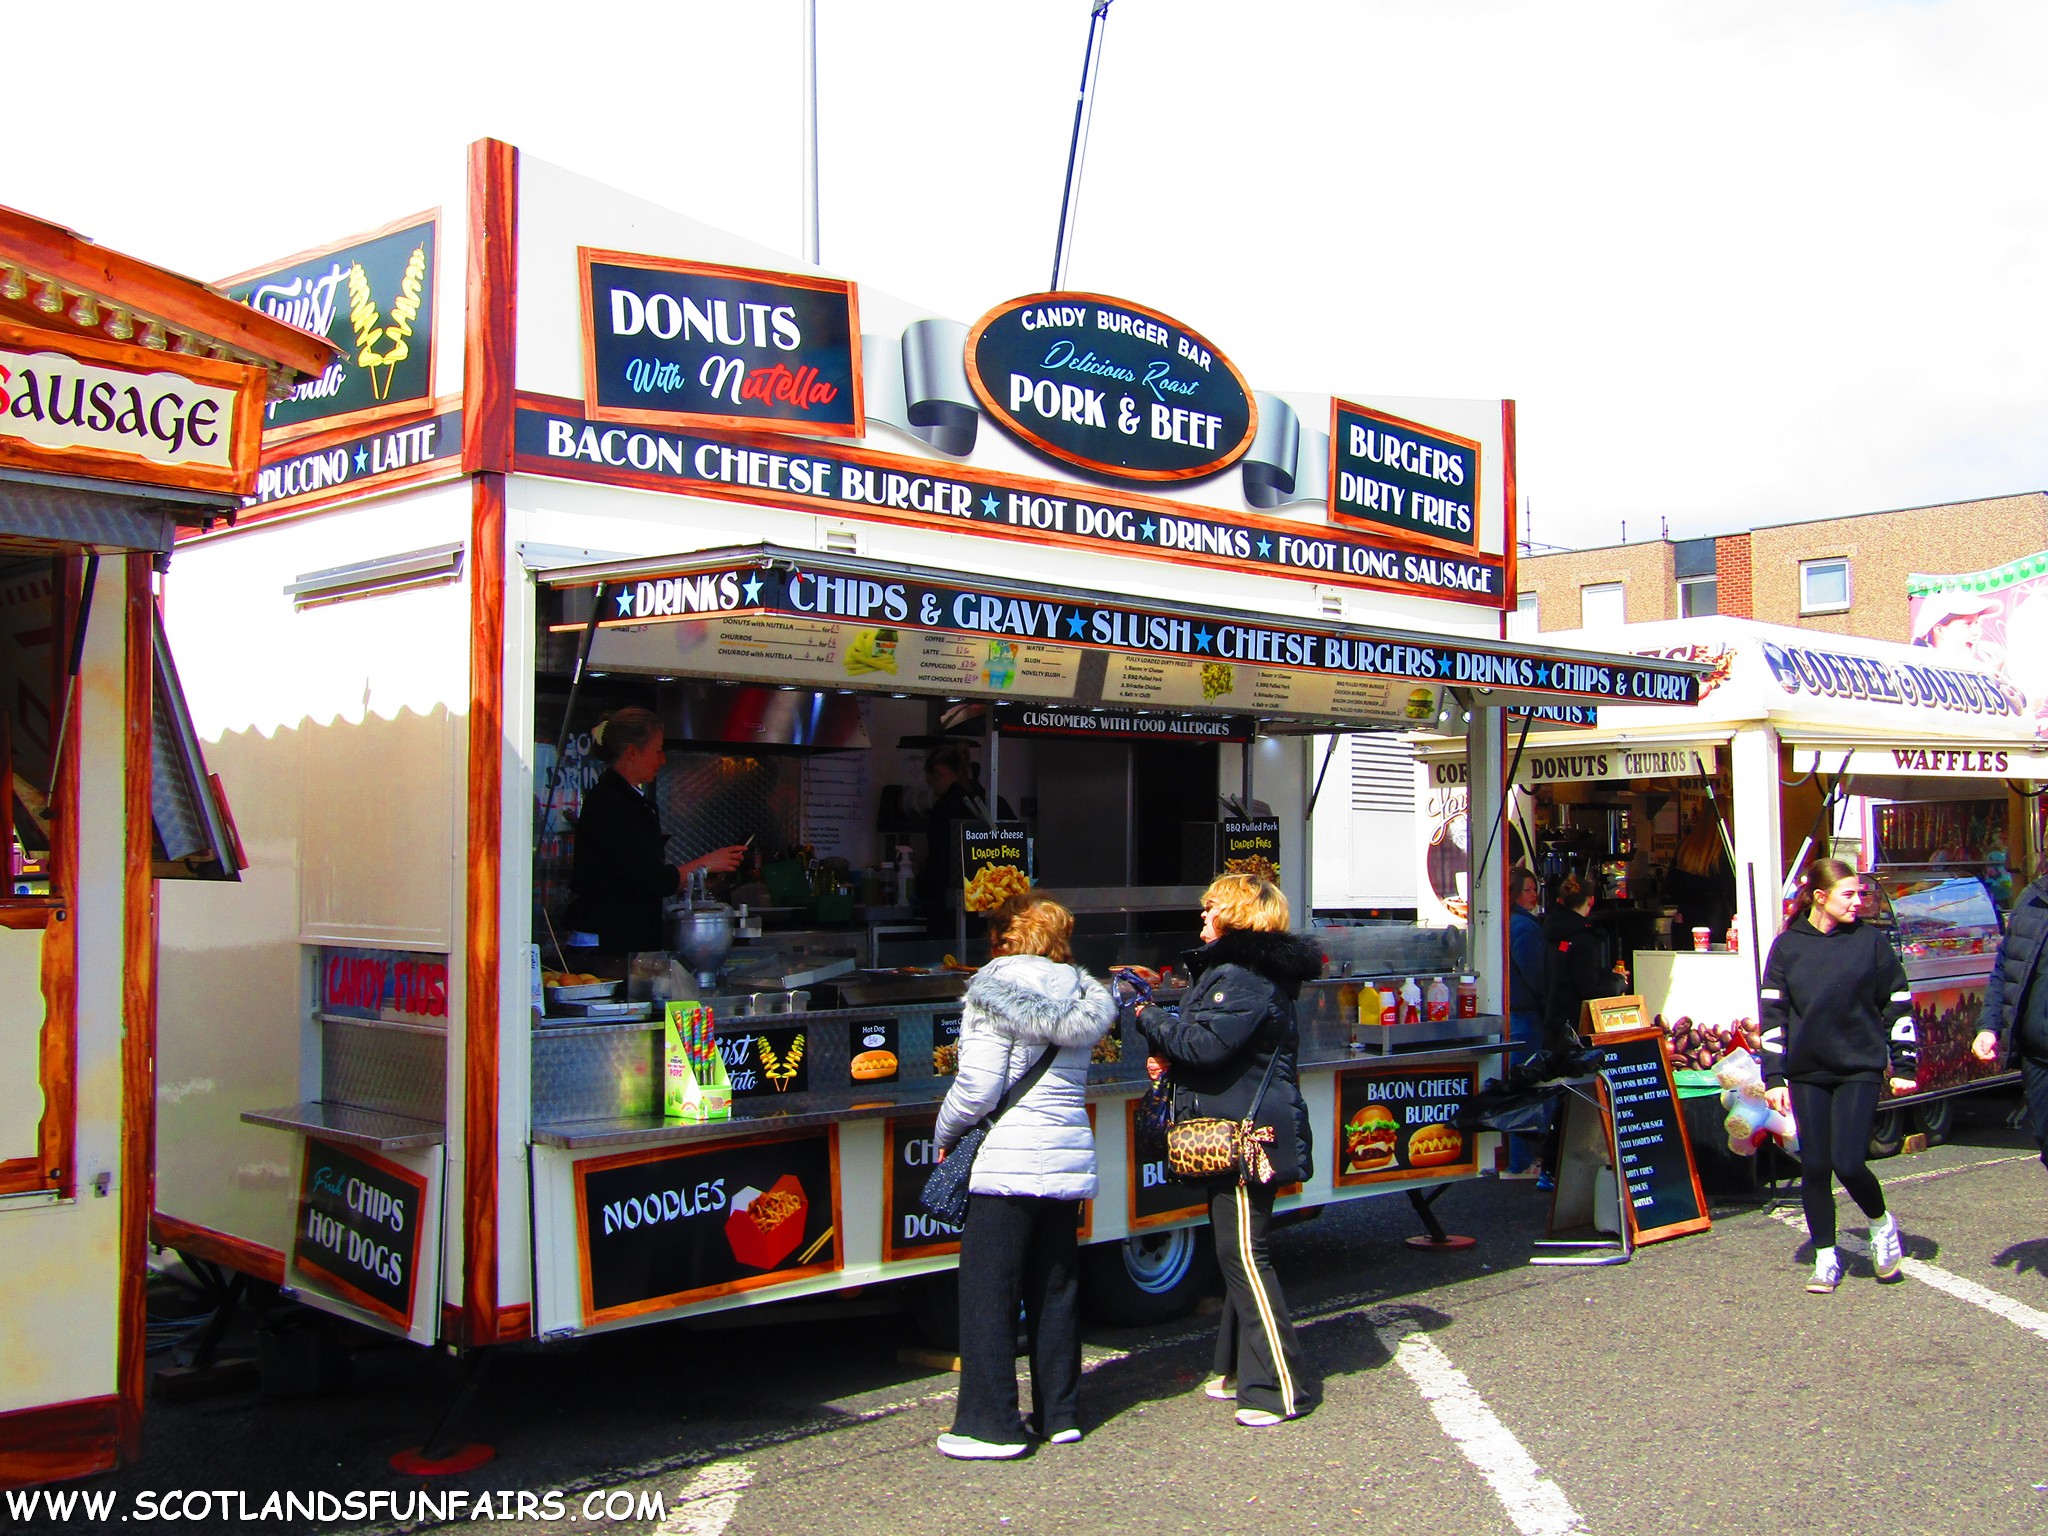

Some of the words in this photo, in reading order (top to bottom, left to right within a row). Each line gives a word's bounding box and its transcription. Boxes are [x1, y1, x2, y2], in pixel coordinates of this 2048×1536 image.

[611, 289, 801, 351] DONUTS
[1021, 308, 1087, 331] CANDY
[1097, 310, 1169, 348] BURGER
[1177, 336, 1212, 373] BAR
[625, 357, 685, 394] With
[699, 355, 838, 410] Nutella
[1040, 340, 1136, 383] Delicious
[1141, 361, 1200, 401] Roast
[1010, 373, 1107, 428] PORK
[1118, 397, 1141, 435] &
[1151, 403, 1222, 450] BEEF
[373, 423, 436, 474] LATTE
[1350, 423, 1464, 487] BURGERS
[547, 420, 682, 474] BACON
[694, 444, 831, 497] CHEESE
[841, 466, 972, 519] BURGER
[1008, 493, 1068, 531] HOT
[1076, 504, 1136, 541] DOG
[1160, 517, 1250, 558] DRINKS
[1279, 536, 1337, 571] FOOT
[1343, 546, 1399, 580] LONG
[1404, 556, 1492, 593] SAUSAGE
[1340, 472, 1405, 516] DIRTY
[1411, 493, 1471, 534] FRIES
[635, 571, 740, 617] DRINKS
[723, 617, 750, 627] DONUTS
[766, 622, 794, 630] NUTELLA
[720, 633, 752, 642] CHURROS
[789, 573, 908, 622] CHIPS
[920, 593, 942, 626] &
[953, 593, 1063, 638] GRAVY
[1092, 610, 1192, 653] SLUSH
[1217, 626, 1317, 665] CHEESE
[1324, 638, 1435, 678] BURGERS
[1456, 652, 1533, 687] DRINKS
[1551, 662, 1611, 694] CHIPS
[1616, 673, 1627, 696] &
[1632, 671, 1690, 701] CURRY
[924, 635, 945, 643] COFFEE
[718, 648, 750, 657] CHURROS
[765, 651, 793, 660] NUTELLA
[922, 648, 939, 656] LATTE
[920, 661, 956, 670] CAPPUCCINO
[930, 675, 963, 684] CHOCOLATE
[1786, 646, 1901, 702] COFFEE
[1902, 662, 2007, 716] DONUTS
[1023, 711, 1097, 729] CUSTOMERS
[1100, 714, 1130, 731] WITH
[1134, 718, 1166, 733] FOOD
[1169, 720, 1229, 736] ALLERGIES
[1531, 754, 1608, 779] DONUTS
[1625, 751, 1686, 775] CHURROS
[1892, 749, 2009, 773] WAFFLES
[965, 829, 989, 840] Bacon
[1000, 829, 1024, 840] cheese
[1225, 822, 1241, 833] BBQ
[1262, 822, 1278, 833] Pork
[972, 846, 1000, 860] LOADED
[1001, 845, 1020, 859] FRIES
[1230, 838, 1254, 851] LOADED
[1255, 838, 1272, 849] FRIES
[329, 955, 387, 1011] CANDY
[394, 959, 449, 1017] FLOS
[873, 1025, 885, 1034] Dog
[1367, 1081, 1415, 1101] BACON
[1418, 1077, 1468, 1098] CHEESE
[1622, 1109, 1634, 1118] DOG
[1622, 1153, 1637, 1164] CHIPS
[1629, 1182, 1649, 1193] DONUTS
[346, 1177, 404, 1232] CHIPS
[603, 1178, 726, 1236] NOODLES
[307, 1208, 345, 1254] HOT
[348, 1231, 402, 1286] DOGS
